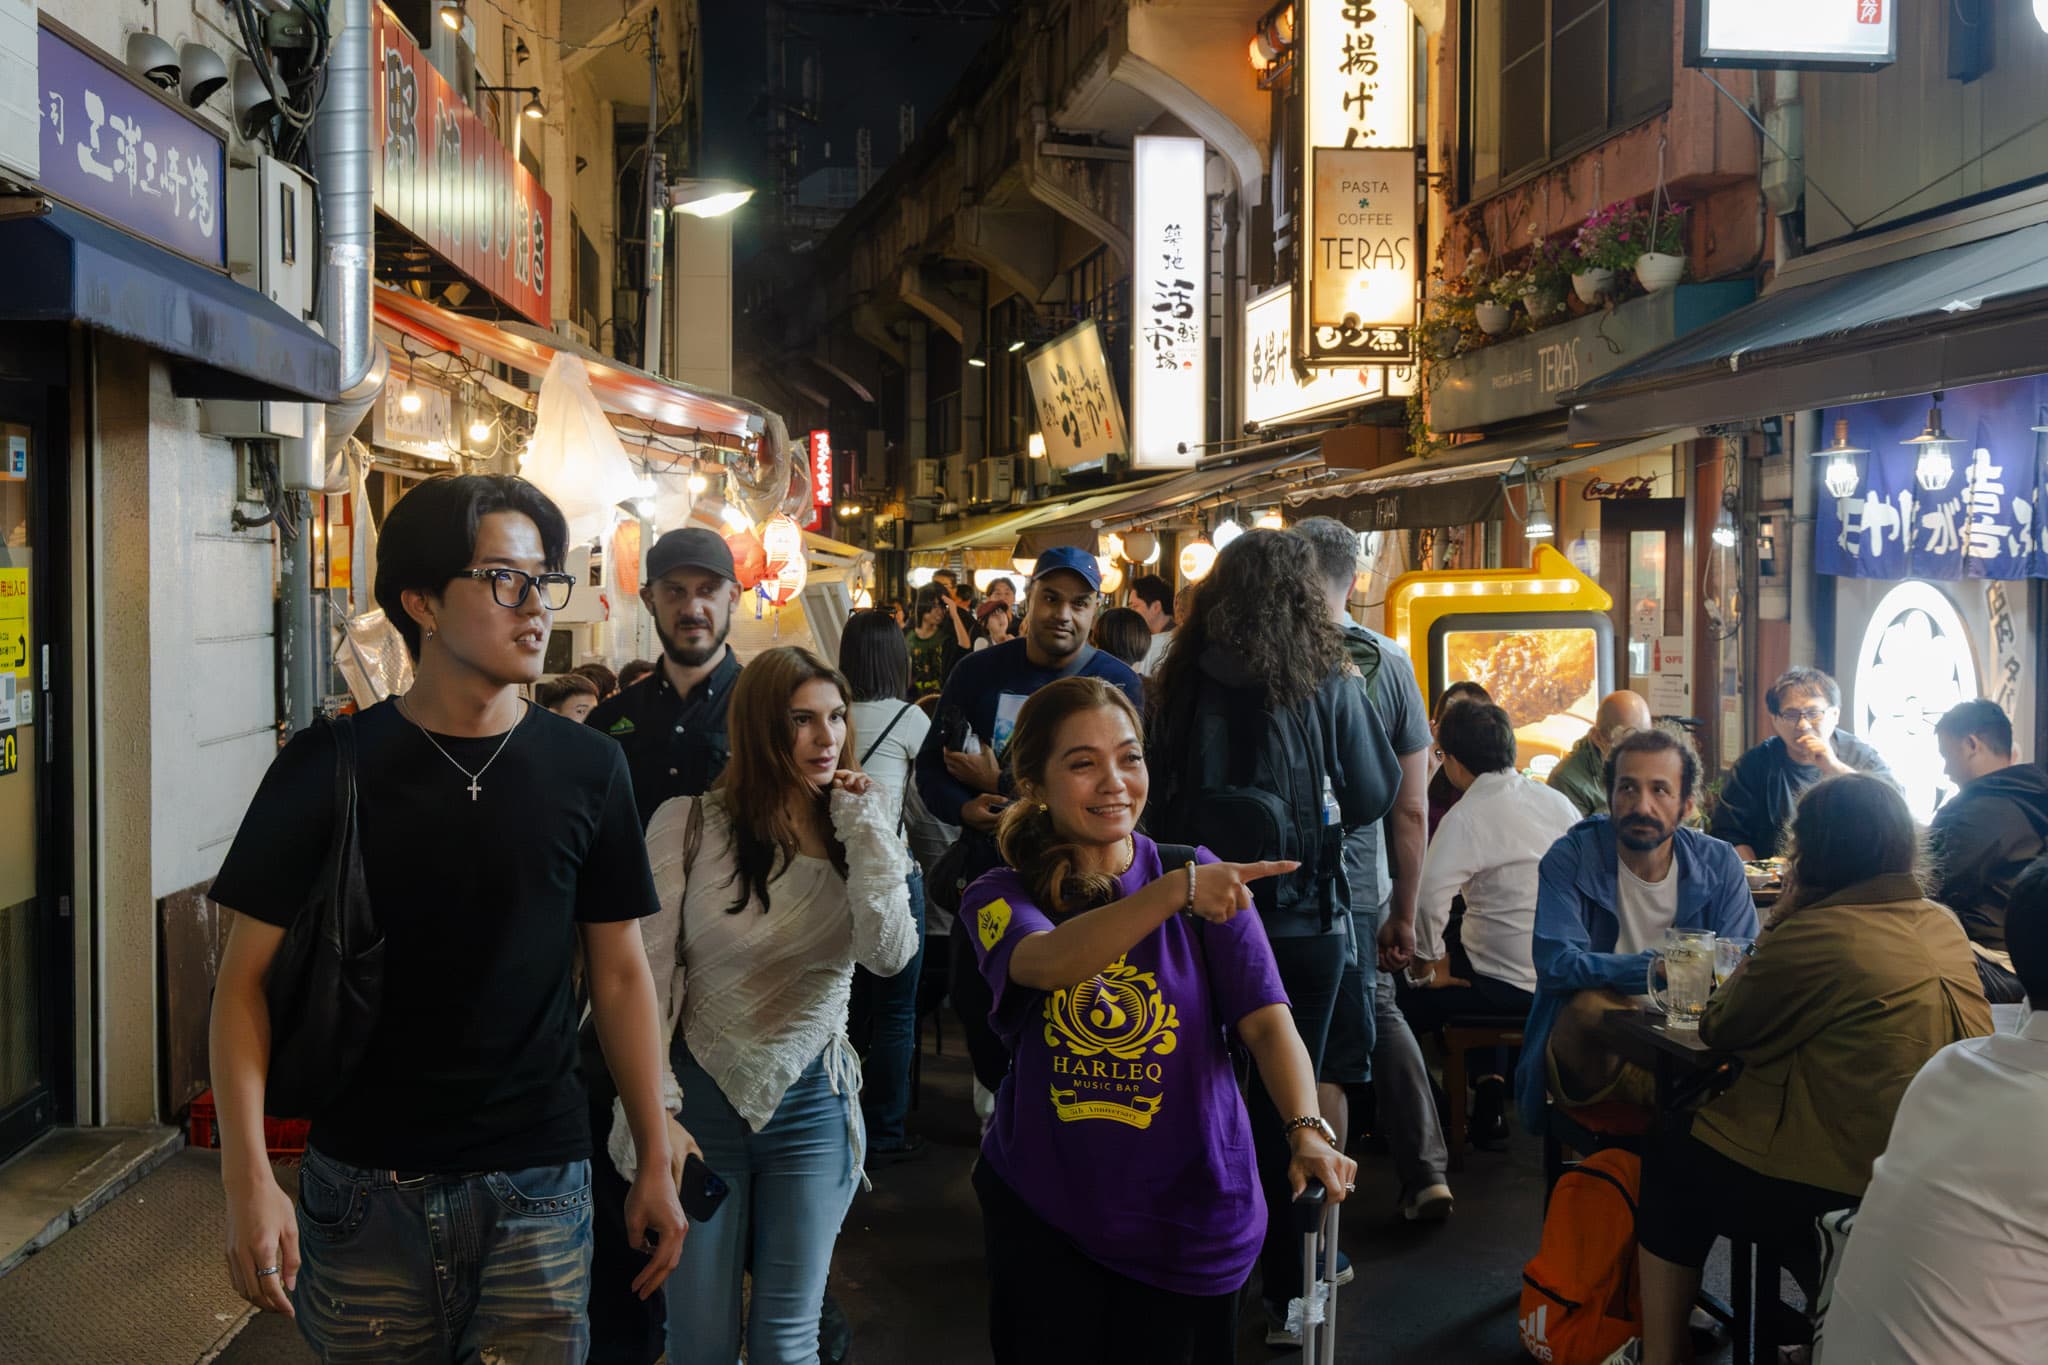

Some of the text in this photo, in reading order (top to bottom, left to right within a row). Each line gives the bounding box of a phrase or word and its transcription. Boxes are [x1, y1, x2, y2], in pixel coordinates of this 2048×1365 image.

[40, 90, 64, 145] 司
[1341, 181, 1390, 193] PASTA
[1337, 213, 1393, 226] COFFEE
[1319, 237, 1410, 270] TERAS
[1538, 337, 1580, 393] TERAS
[1053, 1056, 1163, 1084] HARLEQ
[1073, 1079, 1140, 1093] MUSIC BAR
[1069, 1106, 1137, 1121] 5th Anniversary
